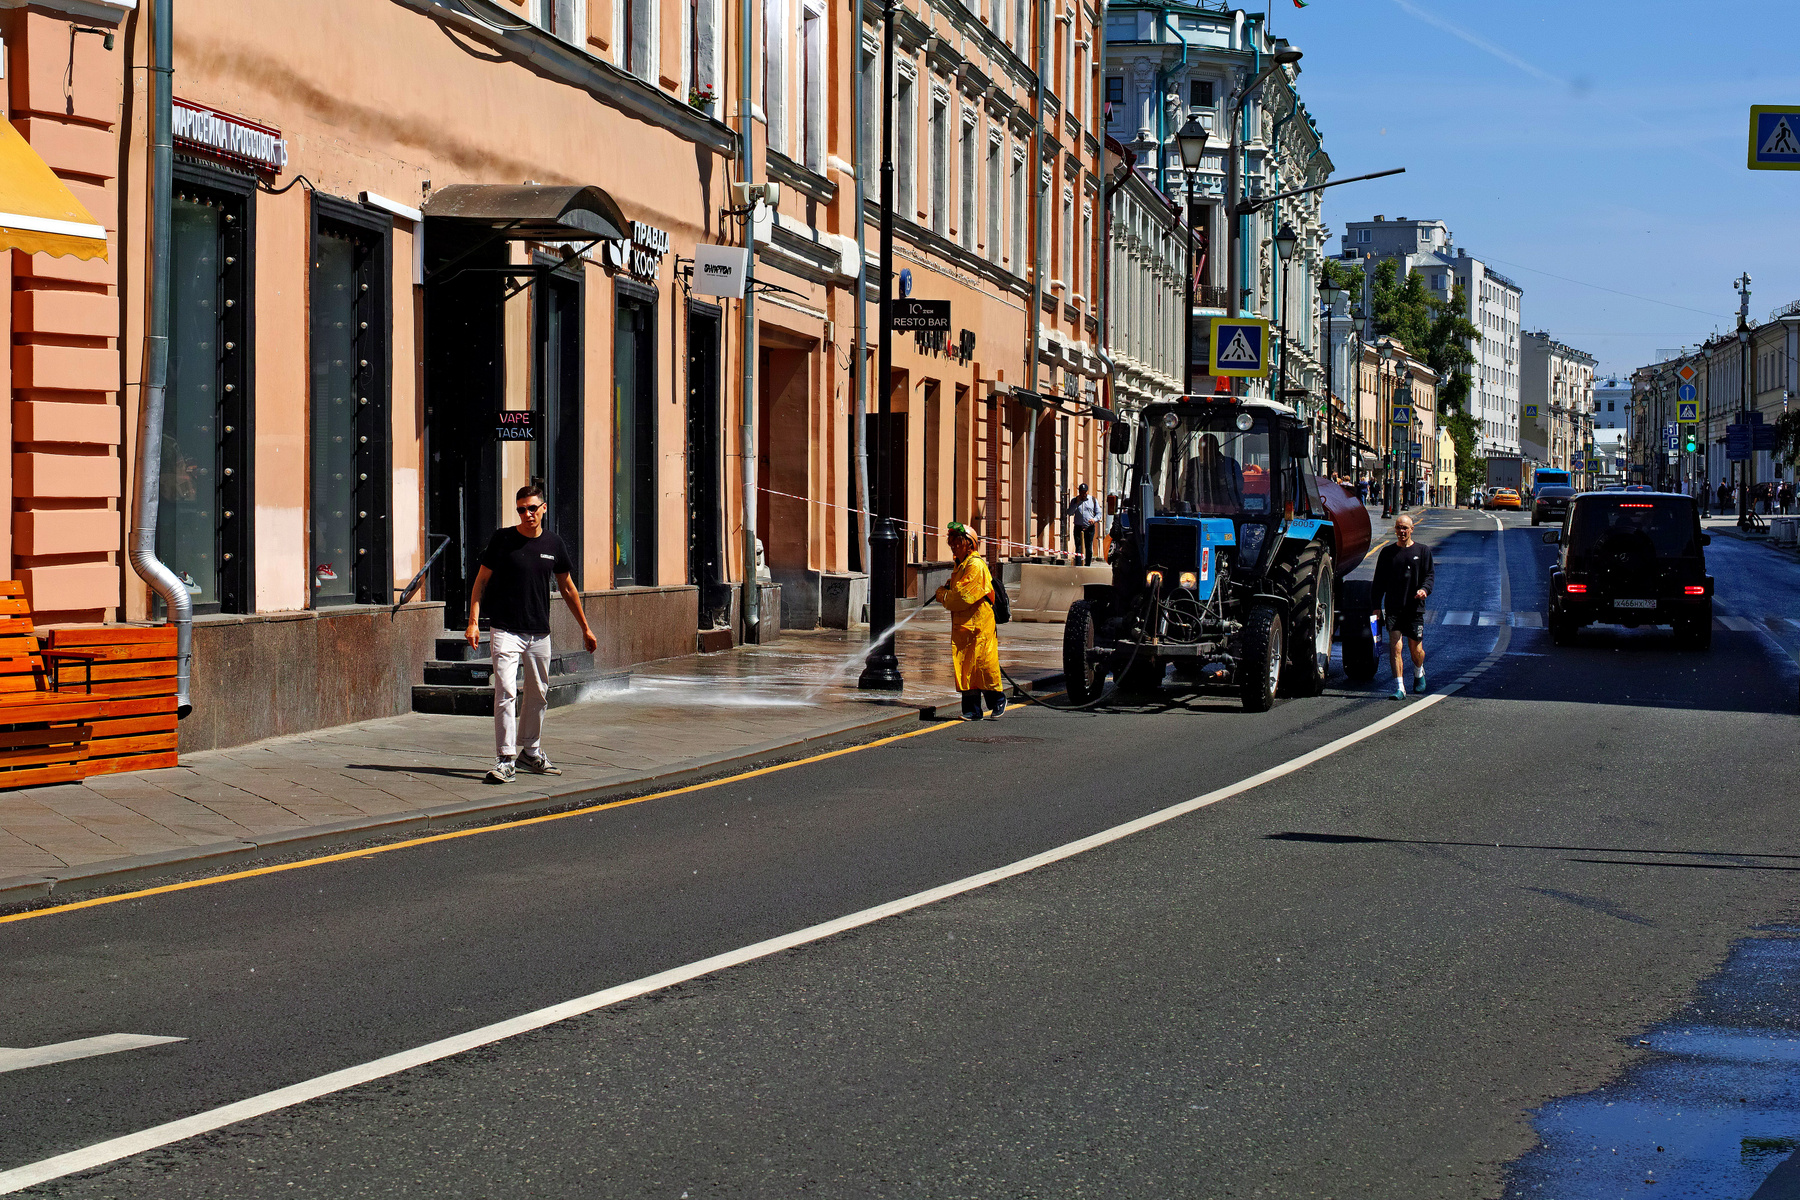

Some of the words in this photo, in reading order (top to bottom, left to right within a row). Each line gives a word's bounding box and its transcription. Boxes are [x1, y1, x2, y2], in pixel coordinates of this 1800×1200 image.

[172, 104, 228, 149] МАРОСЕЙКА
[230, 123, 276, 163] КРОССОВОК
[634, 220, 670, 256] ПРАВДА
[635, 249, 660, 280] КОФЕ
[893, 317, 926, 326] RESTO
[928, 318, 948, 327] BAR
[499, 412, 530, 424] VAPE
[495, 427, 534, 439] ТАБАК
[1671, 437, 1679, 448] P
[1292, 520, 1315, 529] 6005
